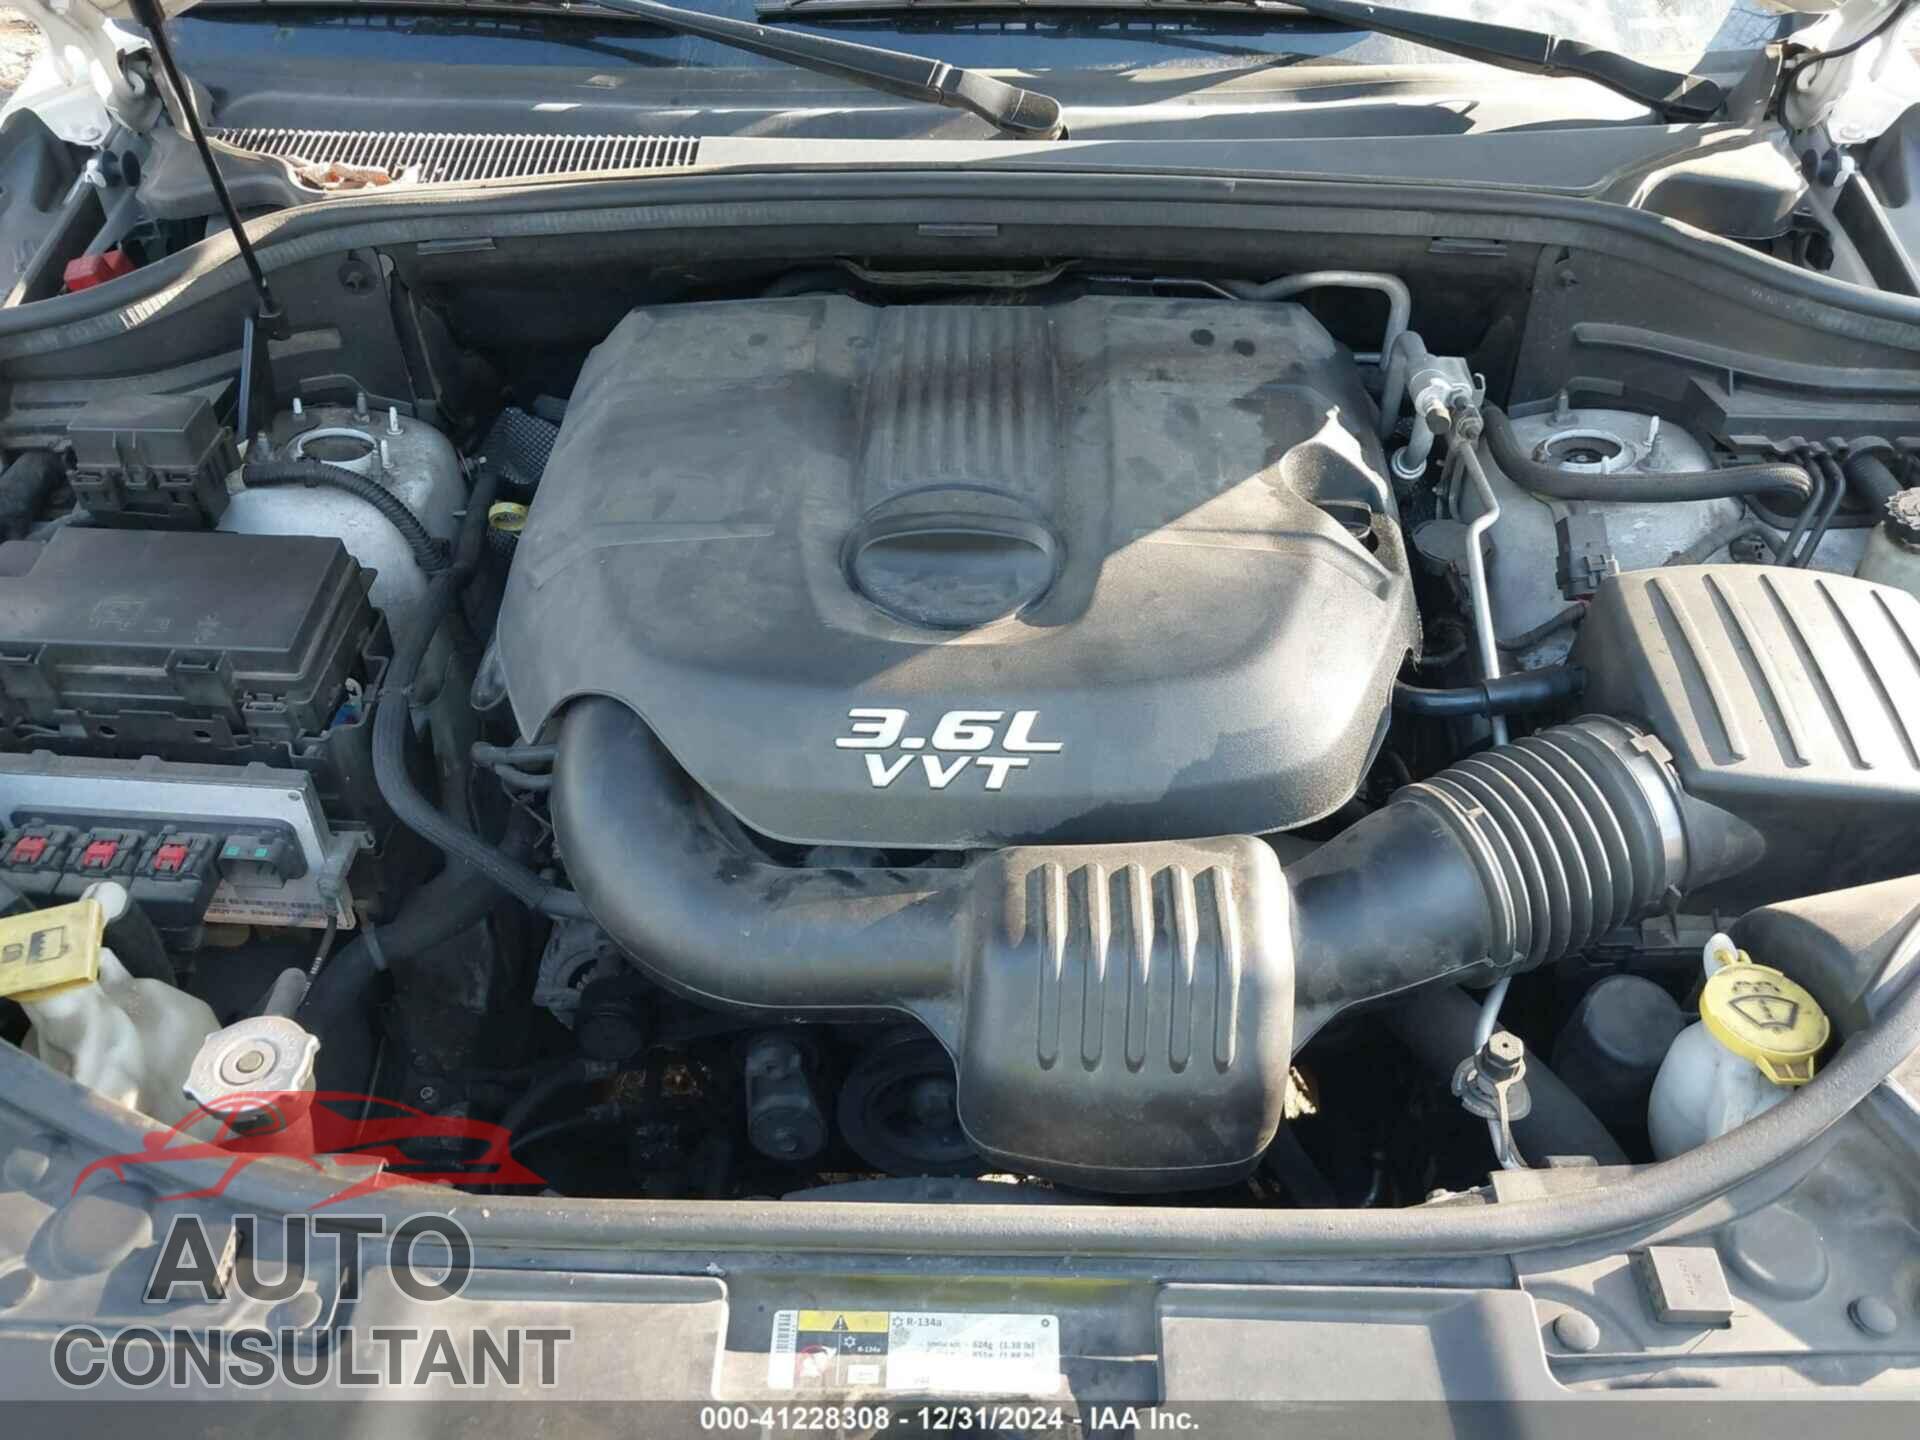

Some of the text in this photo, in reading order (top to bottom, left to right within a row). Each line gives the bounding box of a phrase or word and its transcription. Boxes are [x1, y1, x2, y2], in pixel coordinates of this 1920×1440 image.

[835, 708, 1064, 753] 3.6L
[864, 754, 1030, 791] VVT
[906, 1317, 943, 1328] R-134a
